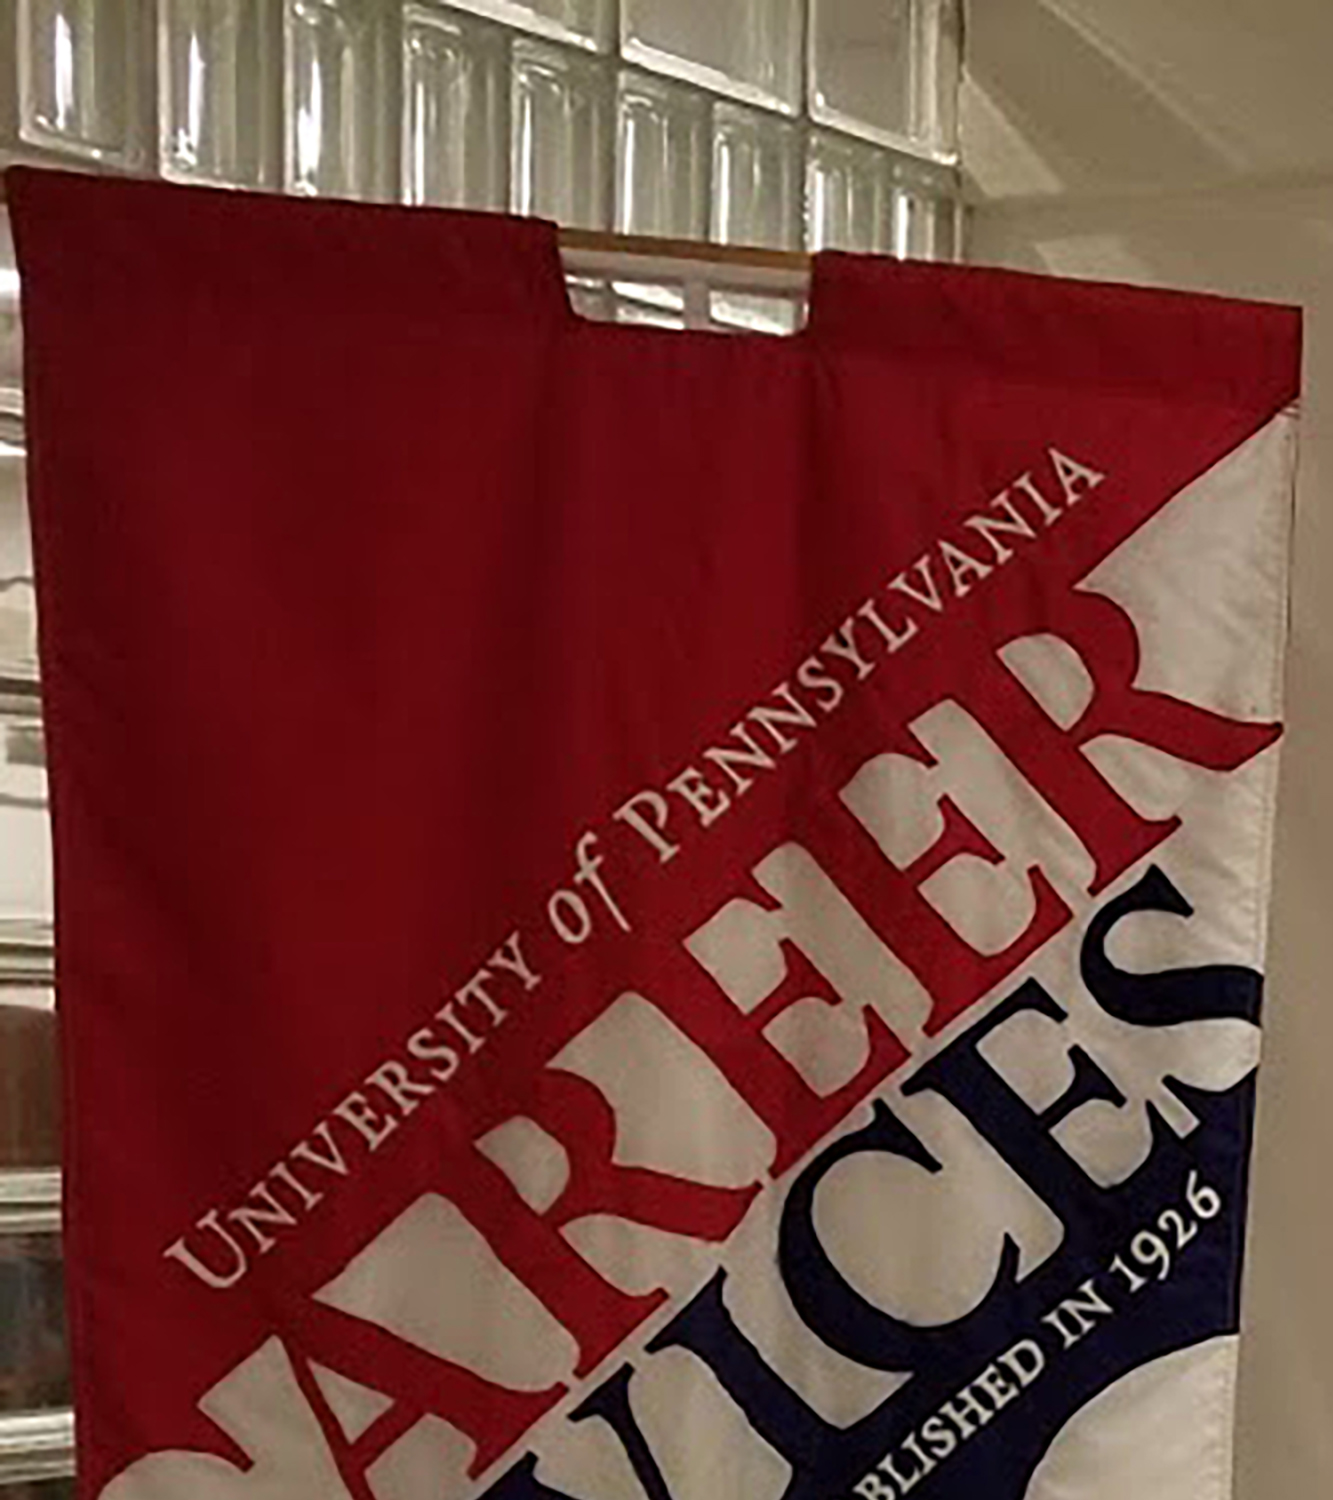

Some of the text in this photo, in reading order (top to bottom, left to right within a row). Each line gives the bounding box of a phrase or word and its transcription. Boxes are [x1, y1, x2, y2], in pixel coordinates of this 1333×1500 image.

[547, 831, 632, 944] of
[1041, 1279, 1114, 1350] IN
[1108, 1169, 1223, 1293] 1926
